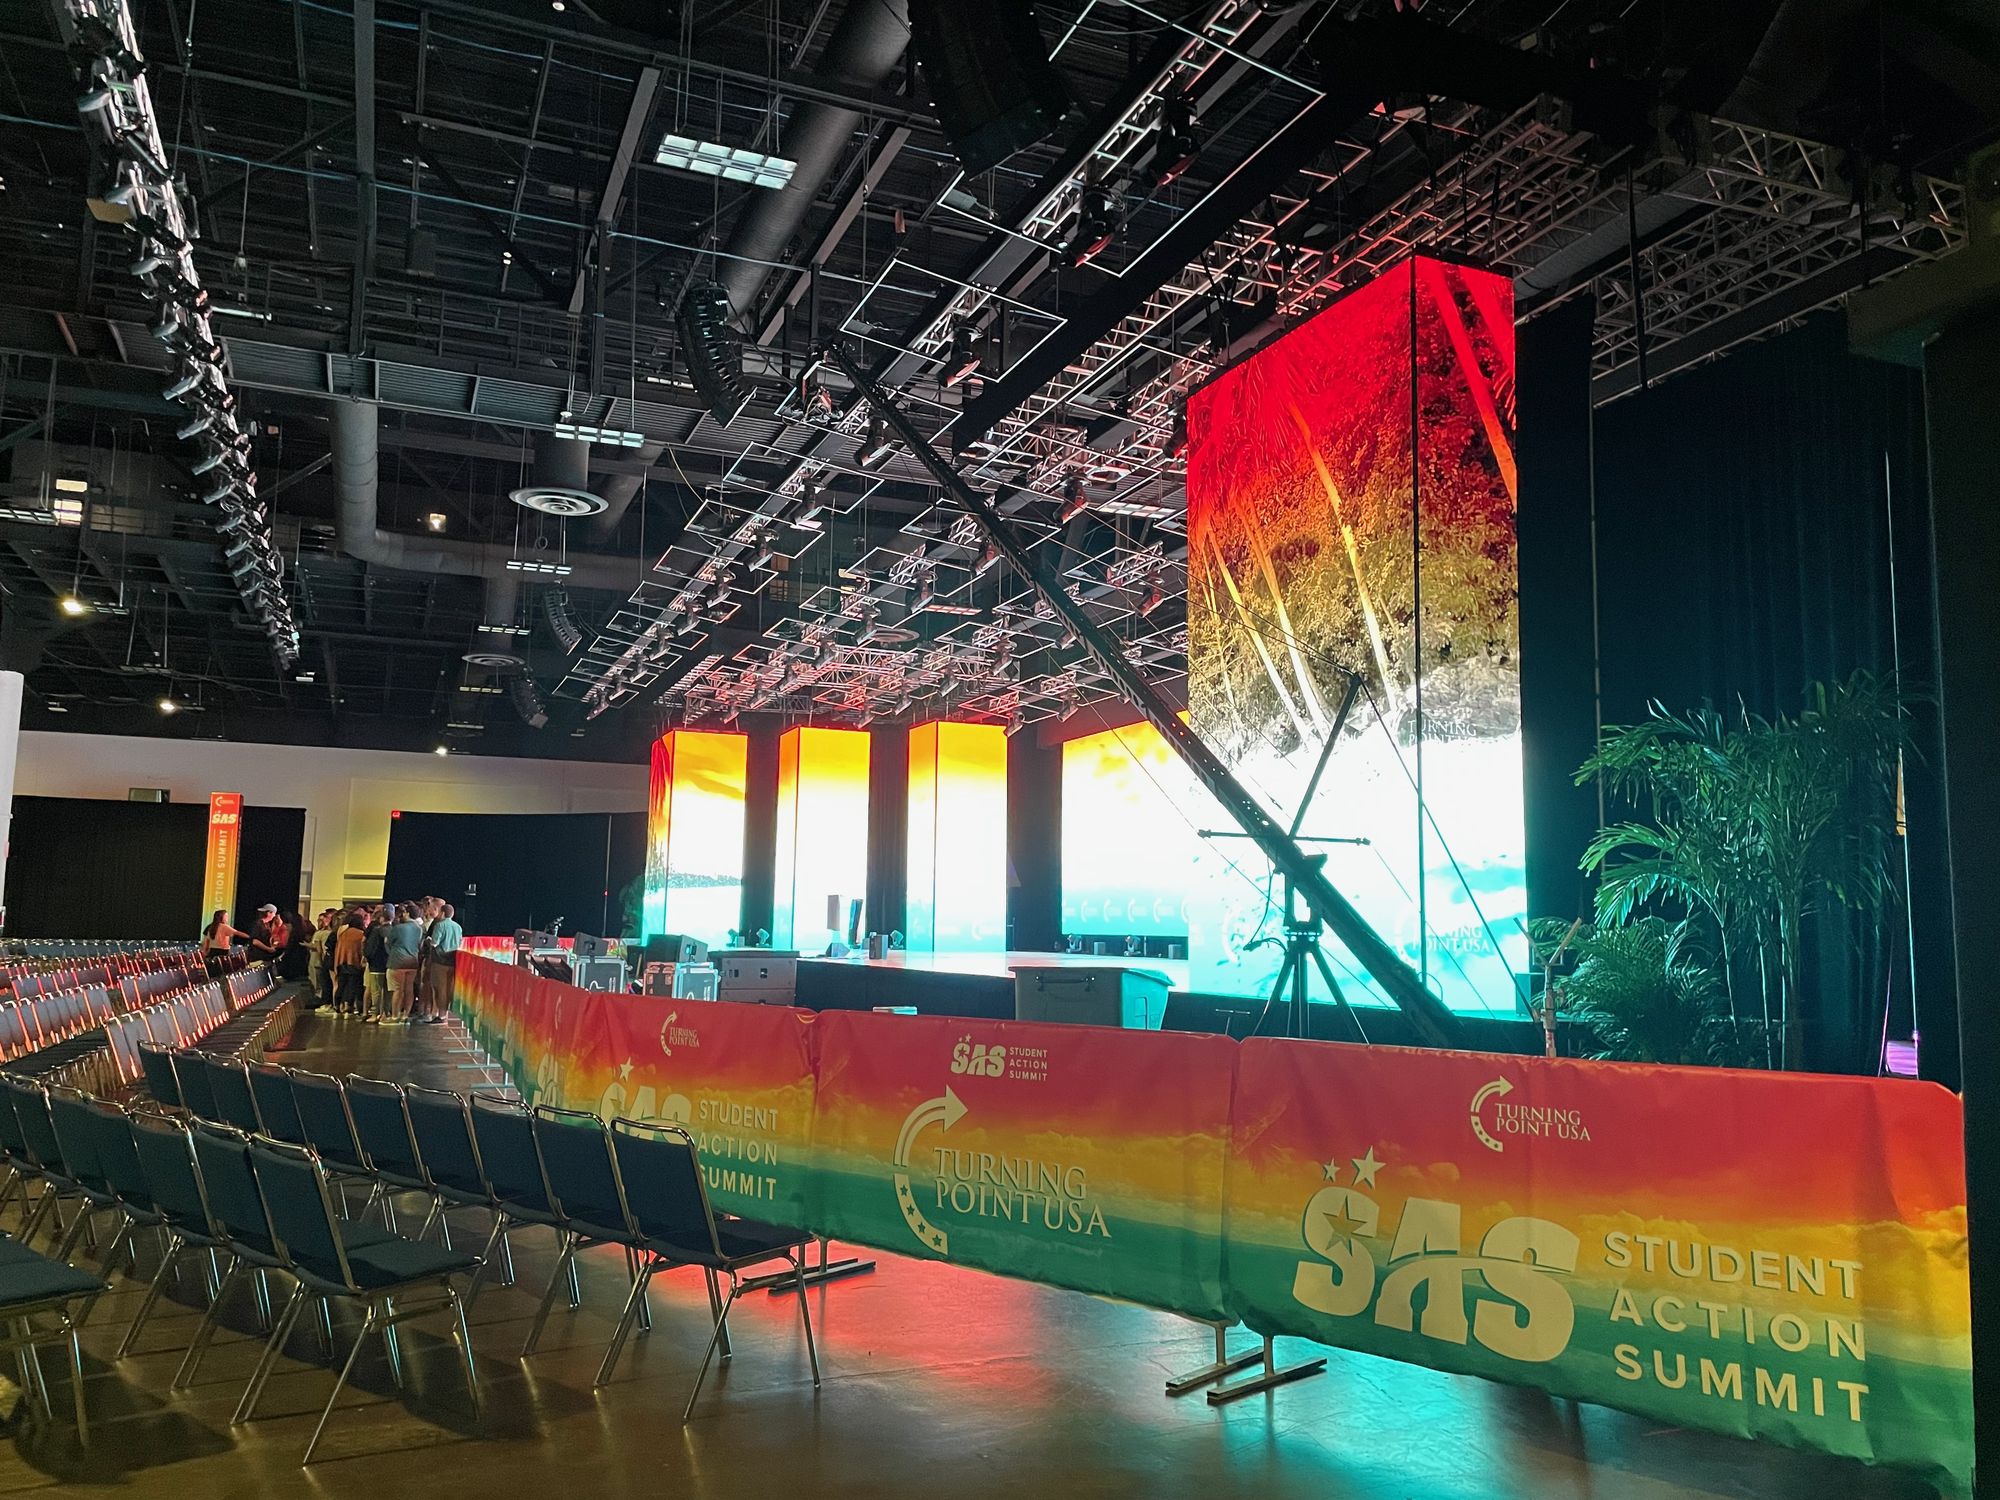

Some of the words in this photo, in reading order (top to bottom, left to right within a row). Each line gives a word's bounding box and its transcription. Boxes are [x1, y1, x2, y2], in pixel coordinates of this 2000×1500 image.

[212, 813, 237, 824] SAS
[217, 829, 228, 869] SUMMIT
[214, 872, 225, 911] ACTION
[950, 1042, 1006, 1077] SAS
[1009, 1046, 1048, 1058] STUDENT
[1009, 1058, 1047, 1070] ACTION
[1009, 1070, 1048, 1081] SUMMIT
[699, 1099, 778, 1131] STUDENT
[1495, 1103, 1581, 1126] TURNING
[1496, 1117, 1552, 1137] POINT
[1558, 1124, 1591, 1142] USA
[697, 1132, 777, 1166] ACTION
[699, 1164, 777, 1200] SUMMIT
[934, 1147, 1086, 1200] TURNING
[934, 1177, 1035, 1224] POINT
[1043, 1196, 1112, 1238] USA
[1292, 1186, 1580, 1362] SAS
[1604, 1231, 1863, 1299] STUDENT
[1609, 1288, 1866, 1361] ACTION
[1614, 1343, 1870, 1422] SUMMIT
